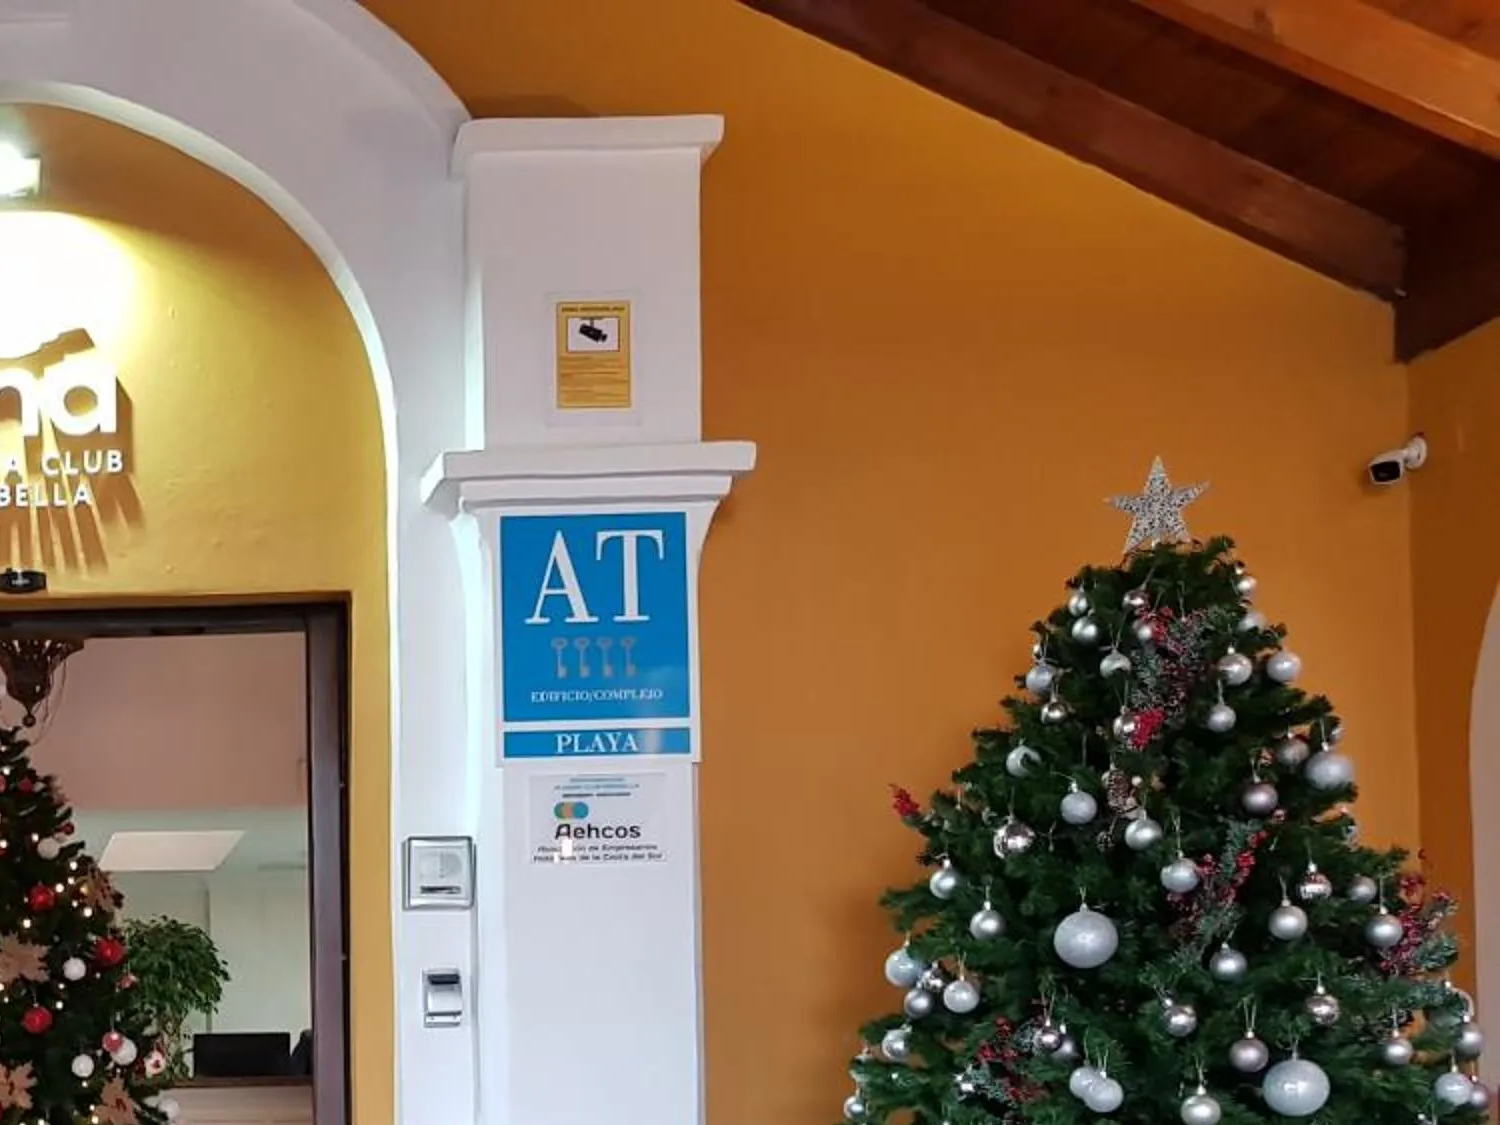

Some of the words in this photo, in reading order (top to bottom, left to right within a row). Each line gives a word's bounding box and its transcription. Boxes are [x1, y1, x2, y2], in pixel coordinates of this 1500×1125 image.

[41, 449, 123, 475] CLUB
[524, 529, 665, 624] AT
[556, 732, 640, 754] PLAYA
[555, 823, 641, 839] Aehcos
